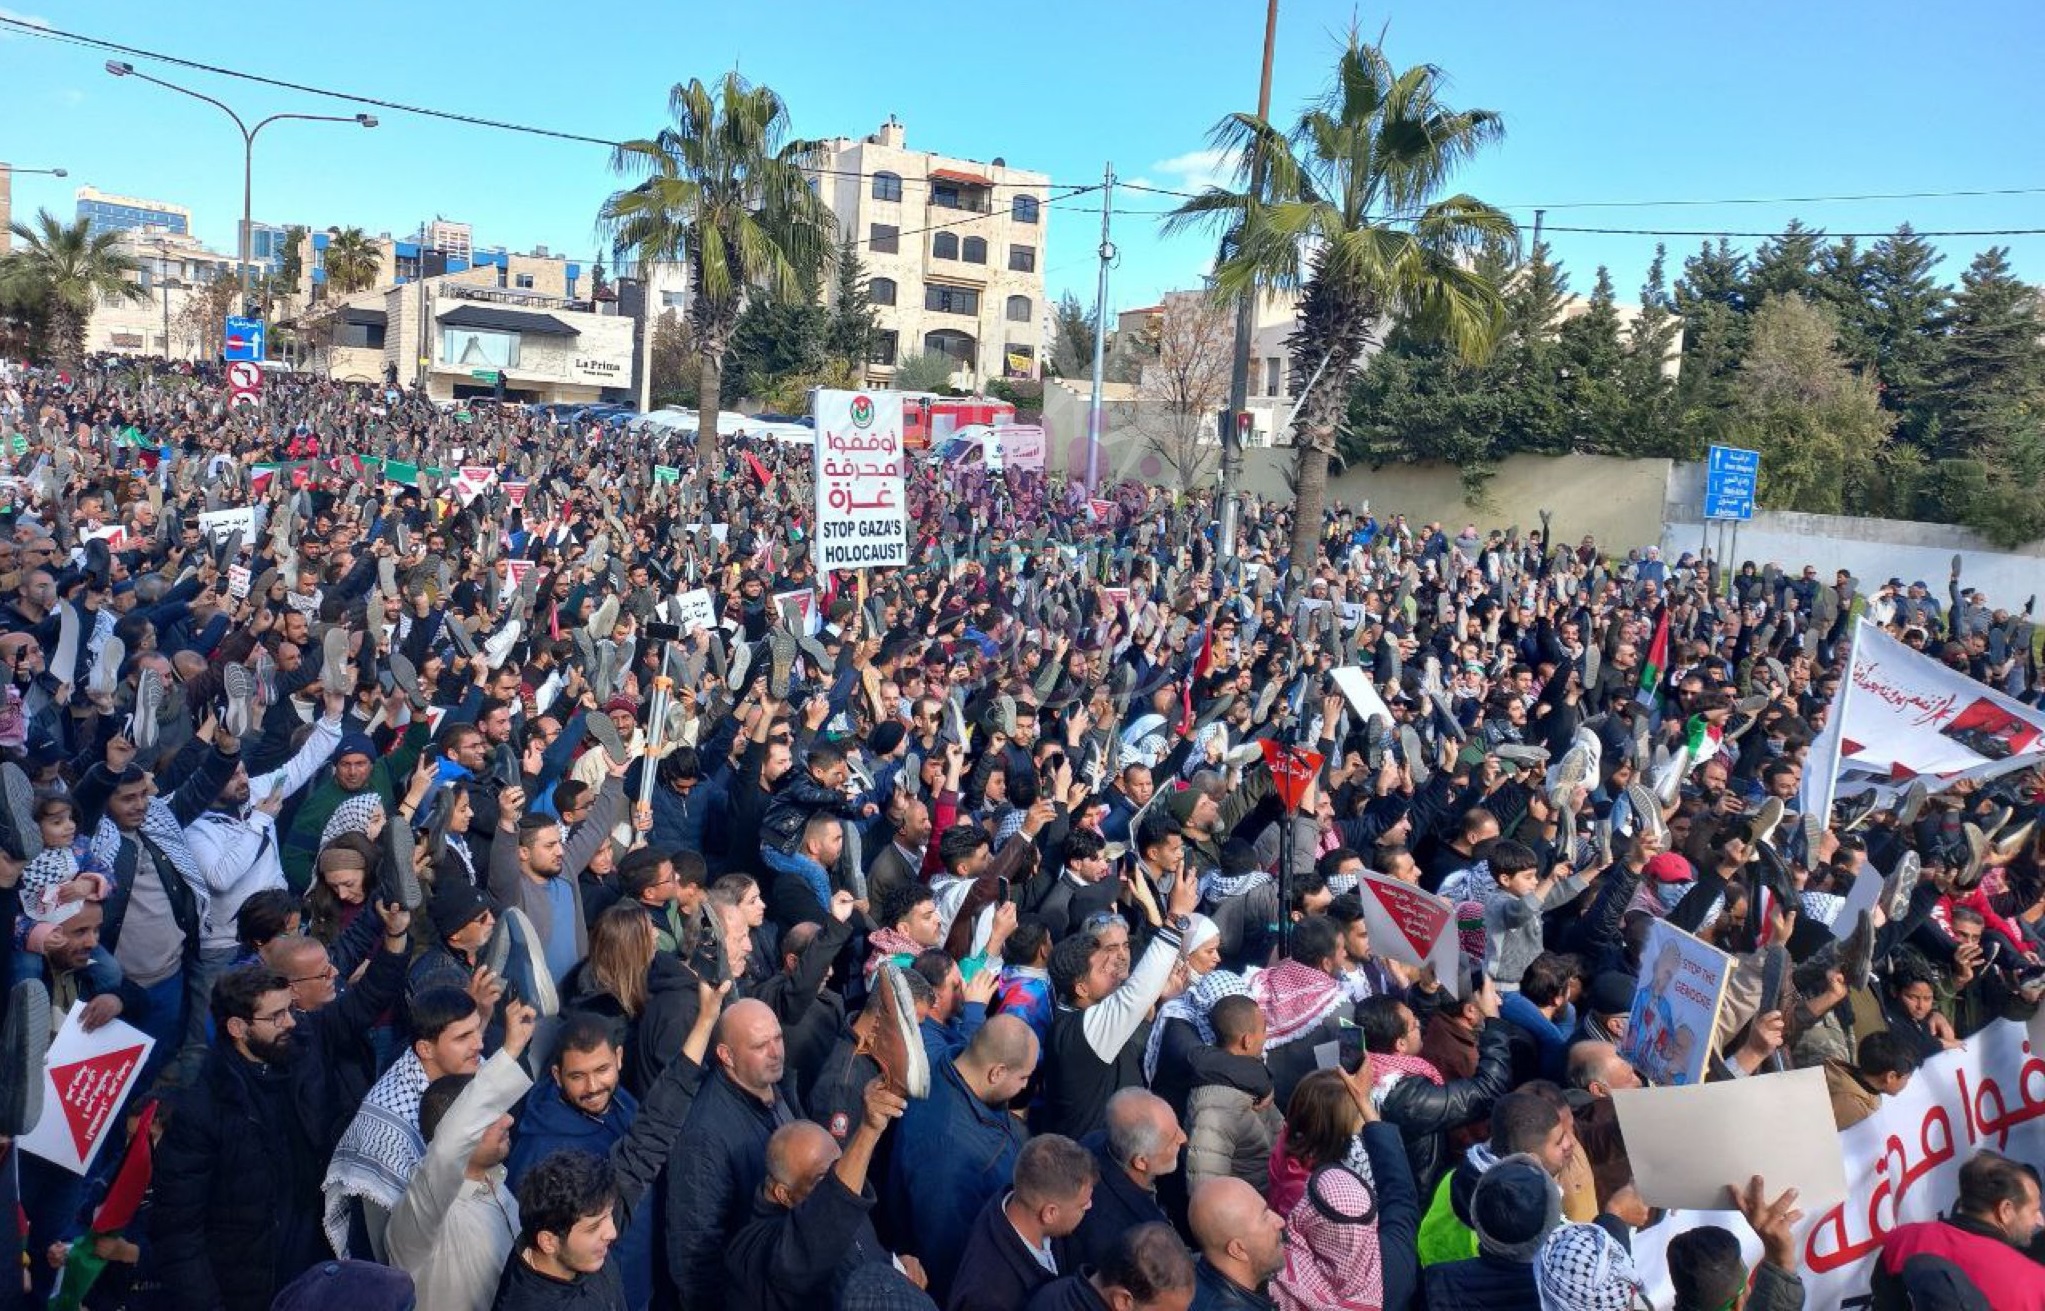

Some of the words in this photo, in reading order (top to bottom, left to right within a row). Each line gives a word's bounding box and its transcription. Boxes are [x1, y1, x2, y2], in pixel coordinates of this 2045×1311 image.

[591, 360, 620, 371] Prima
[827, 431, 896, 455] أوقفوا
[824, 458, 897, 481] محرقة
[829, 482, 895, 514] غزة
[824, 520, 855, 538] STOP
[859, 520, 901, 537] GAZA'S
[825, 543, 904, 563] HOLOCAUST
[1683, 958, 1701, 976] STOP
[1701, 969, 1717, 986] THE
[1675, 980, 1713, 1011] GENOCIDE
